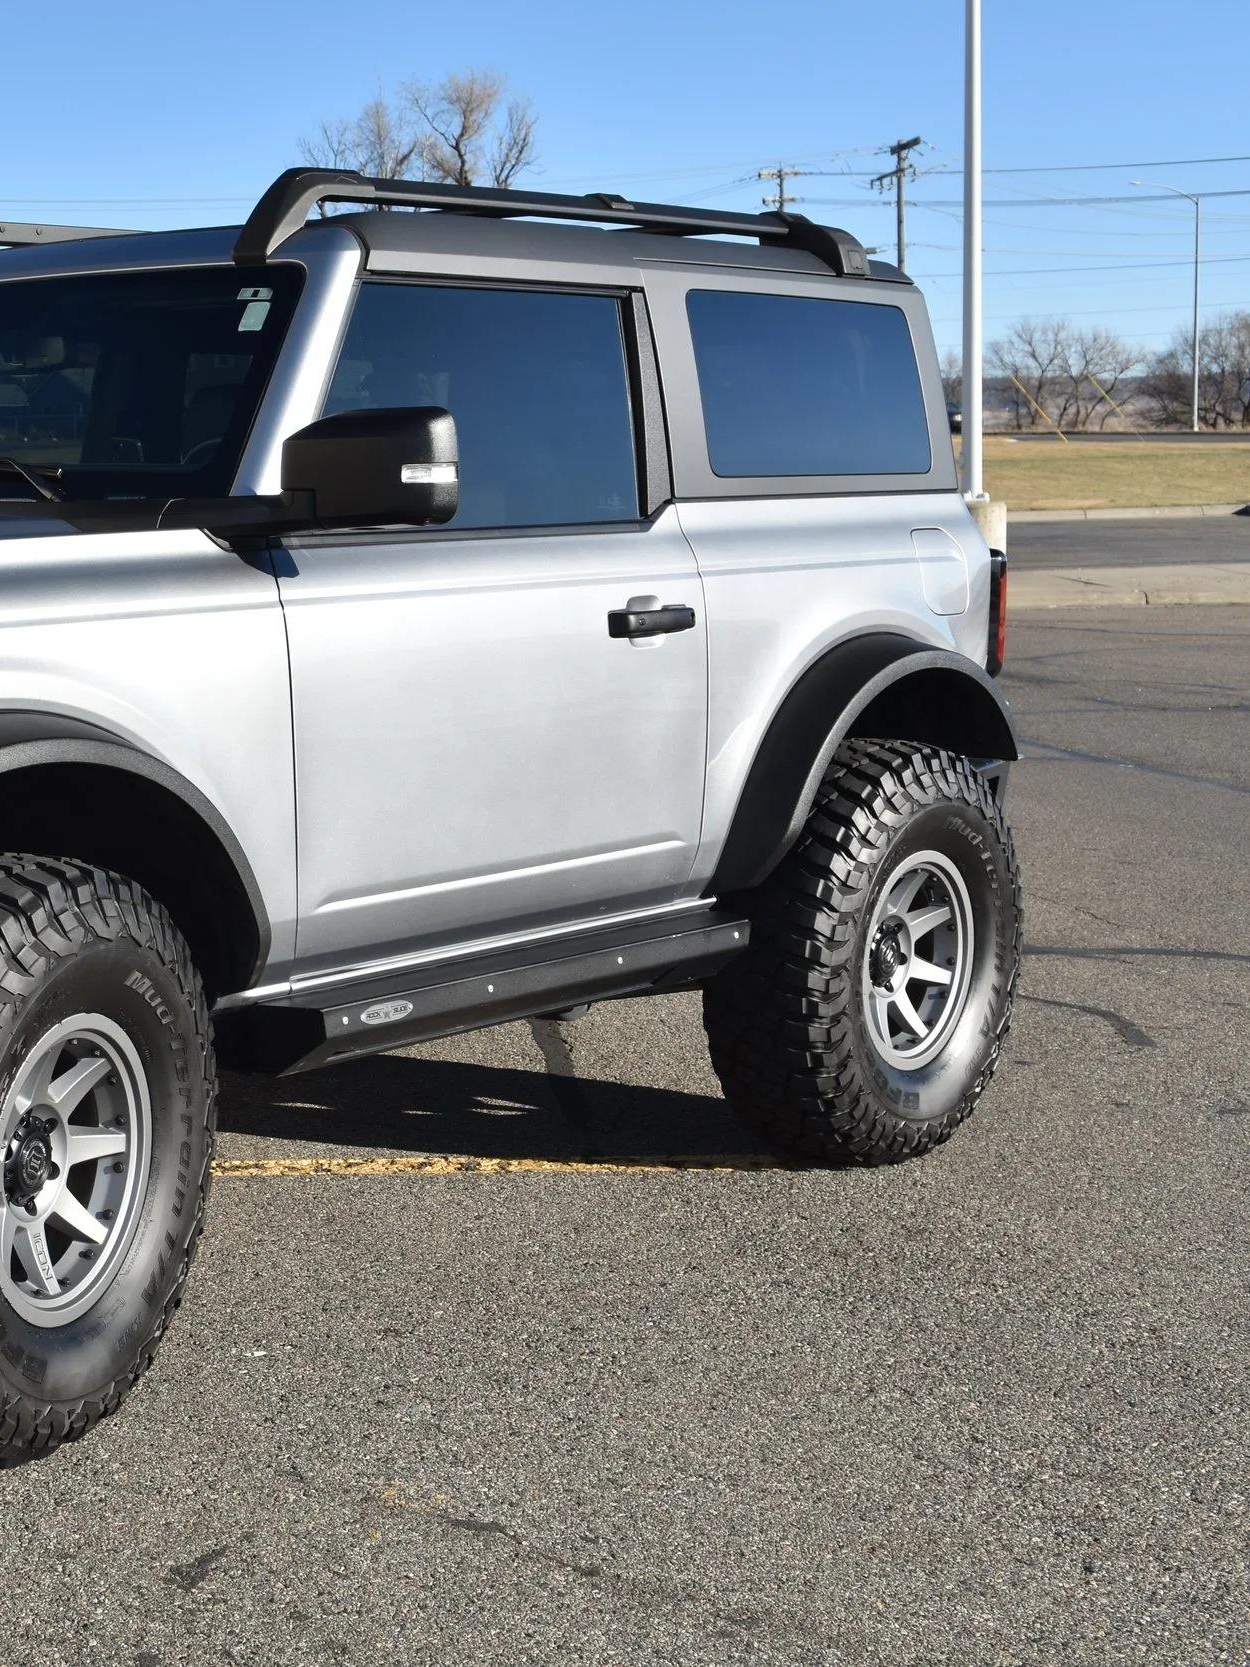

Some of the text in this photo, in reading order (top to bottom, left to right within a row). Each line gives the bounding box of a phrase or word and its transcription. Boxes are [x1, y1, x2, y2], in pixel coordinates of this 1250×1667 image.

[946, 815, 1006, 972] Mud-Ter
[123, 969, 192, 1217] Mud-Terrain
[33, 1231, 54, 1281] ICON
